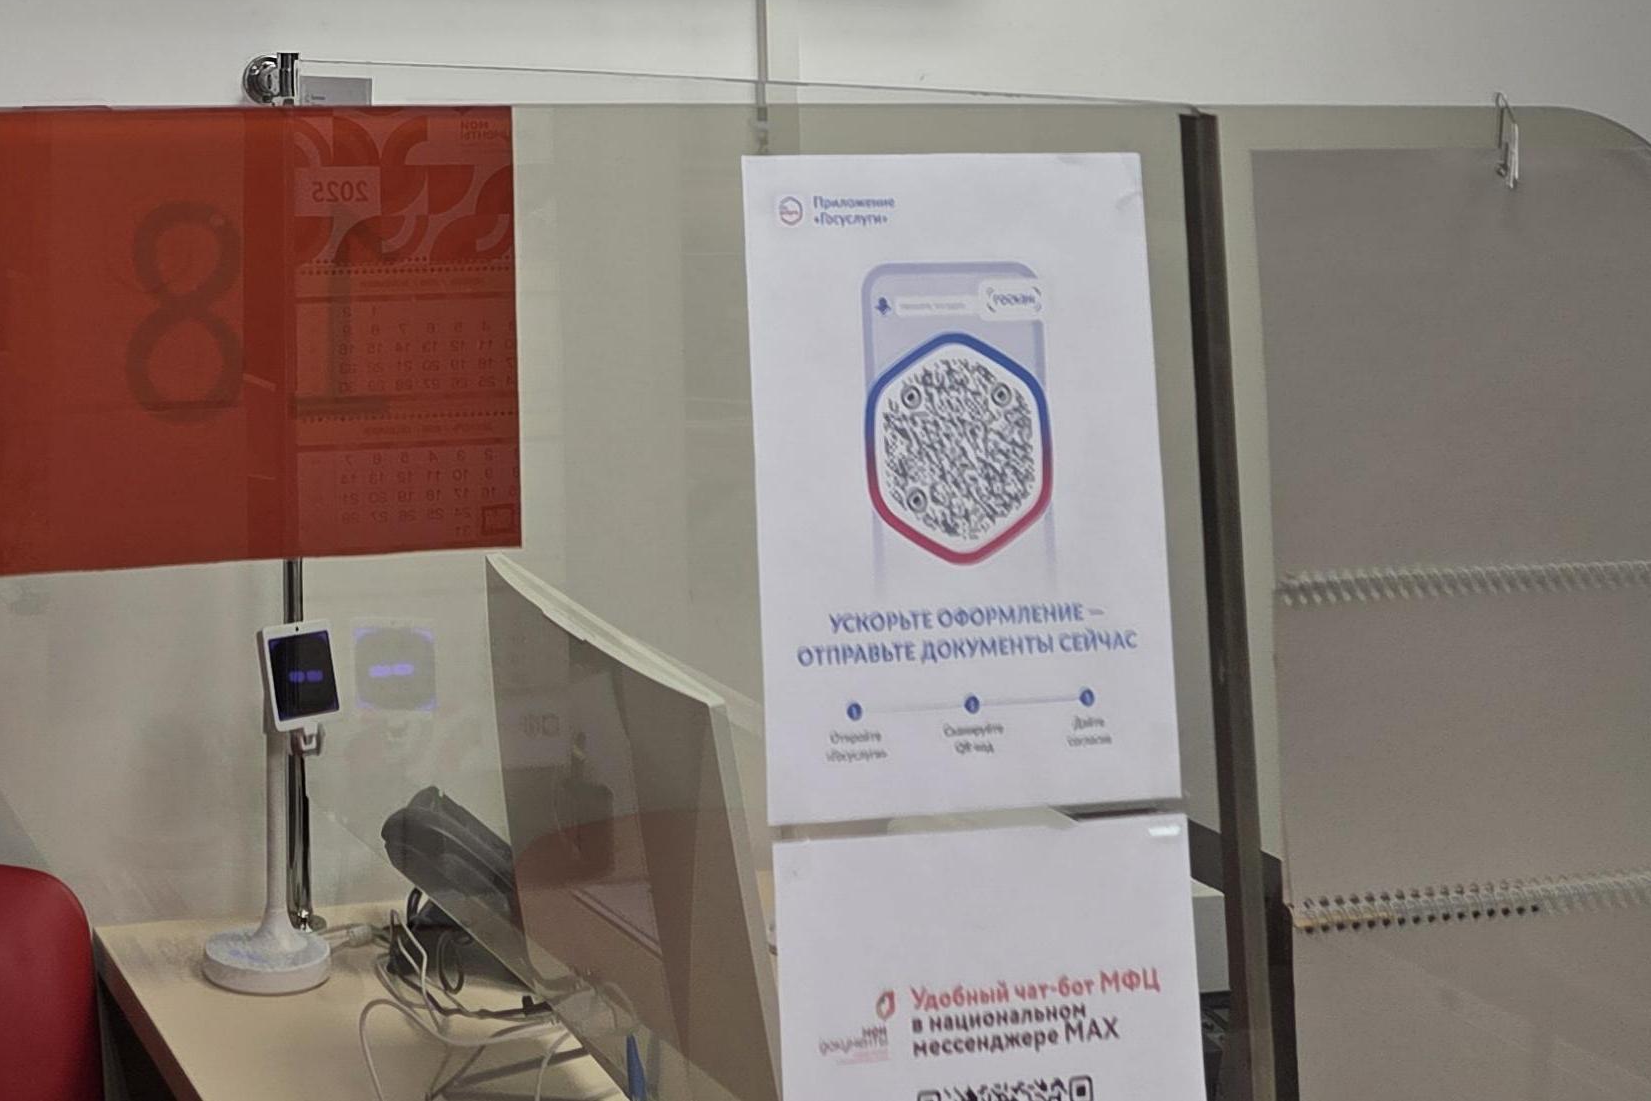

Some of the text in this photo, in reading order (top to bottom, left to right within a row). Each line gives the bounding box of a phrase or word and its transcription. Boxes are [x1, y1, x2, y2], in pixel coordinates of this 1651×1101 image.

[813, 195, 895, 210] Приложение
[813, 211, 888, 227] «Госуслуги»
[829, 610, 933, 634] УСКОРЬТЕ
[937, 602, 1084, 629] ОФОРМЛЕНИЕ
[797, 628, 1138, 667] ОТПРАВЬТЕ ДОКУМЕНТЫ СЕЙЧАС
[910, 967, 1162, 1011] Удобный чат-бот МФЦ
[911, 1001, 1087, 1034] в национальном
[912, 1027, 1060, 1058] мессенджере
